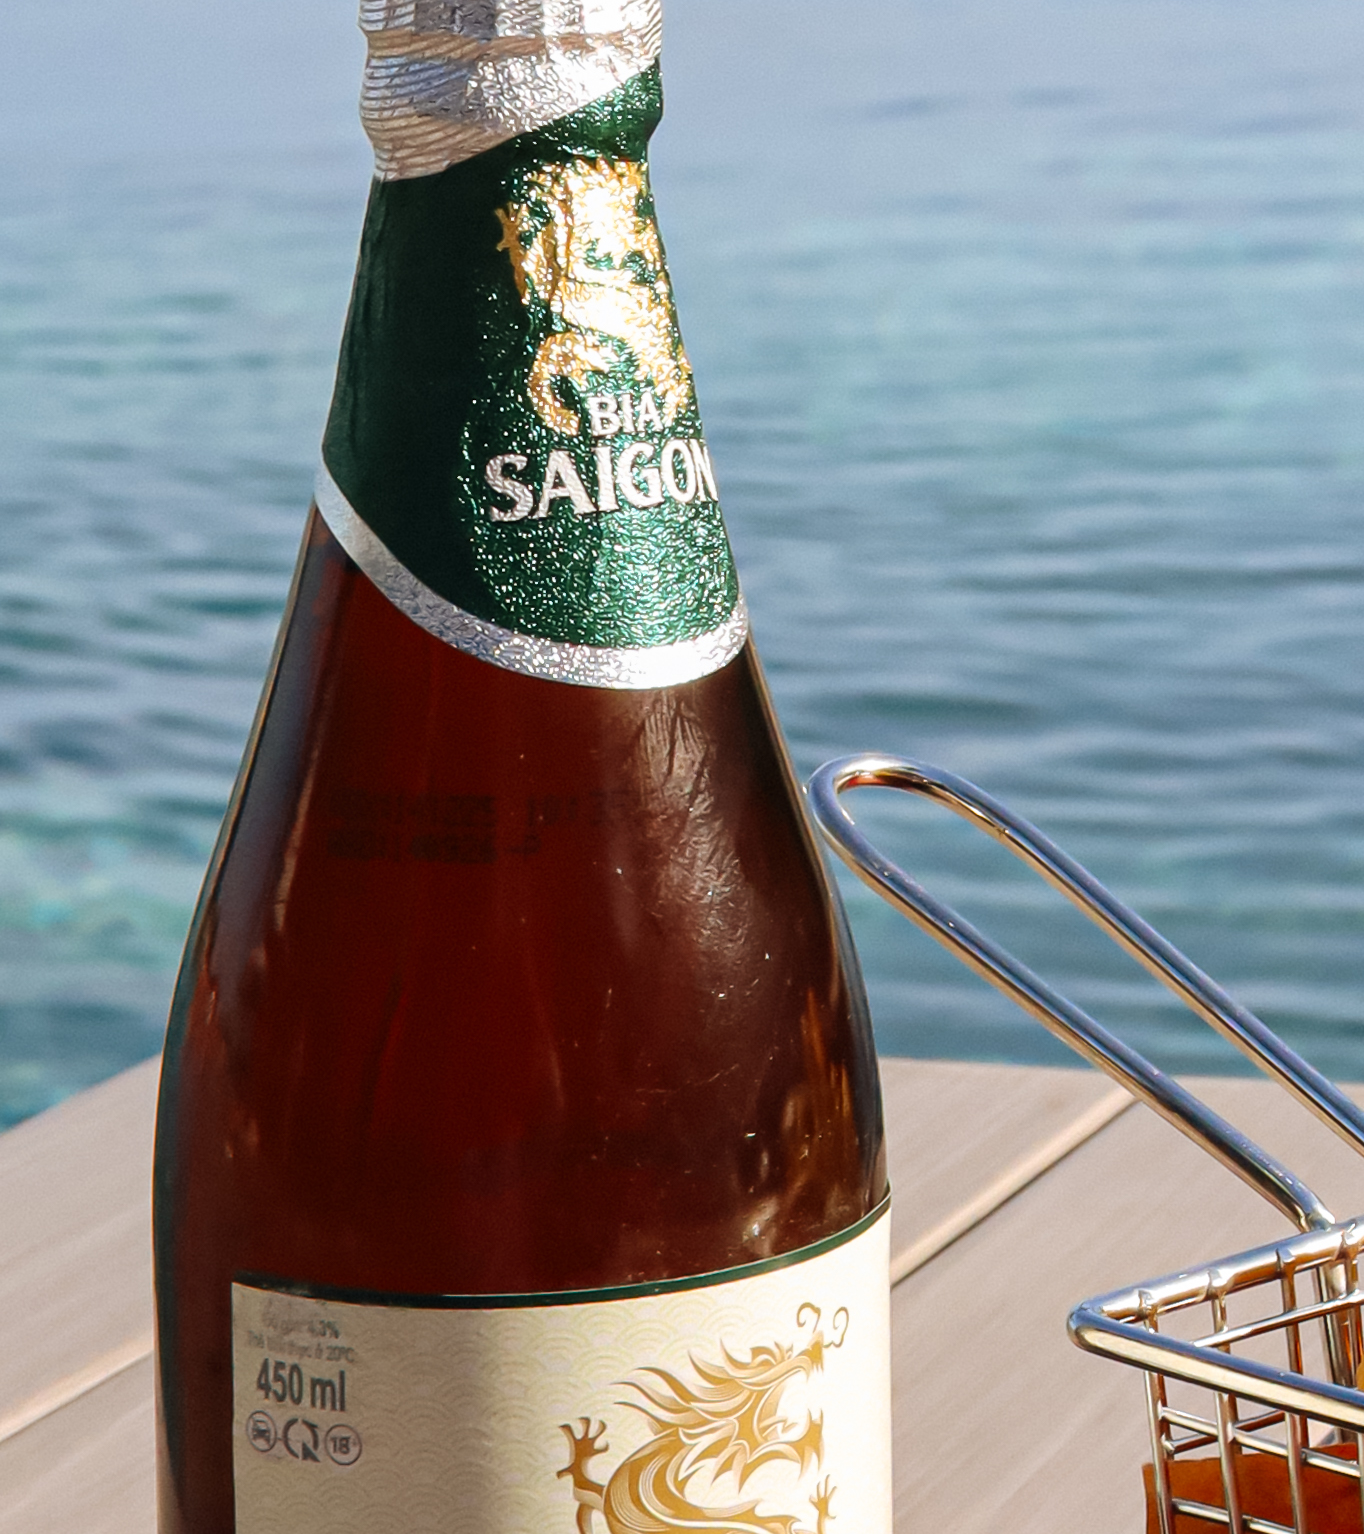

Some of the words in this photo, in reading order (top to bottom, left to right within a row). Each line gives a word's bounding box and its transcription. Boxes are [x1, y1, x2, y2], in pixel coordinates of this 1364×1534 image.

[588, 391, 664, 436] BIA
[485, 438, 719, 523] SAIGON
[256, 1358, 304, 1406] 450
[309, 1370, 346, 1412] ml
